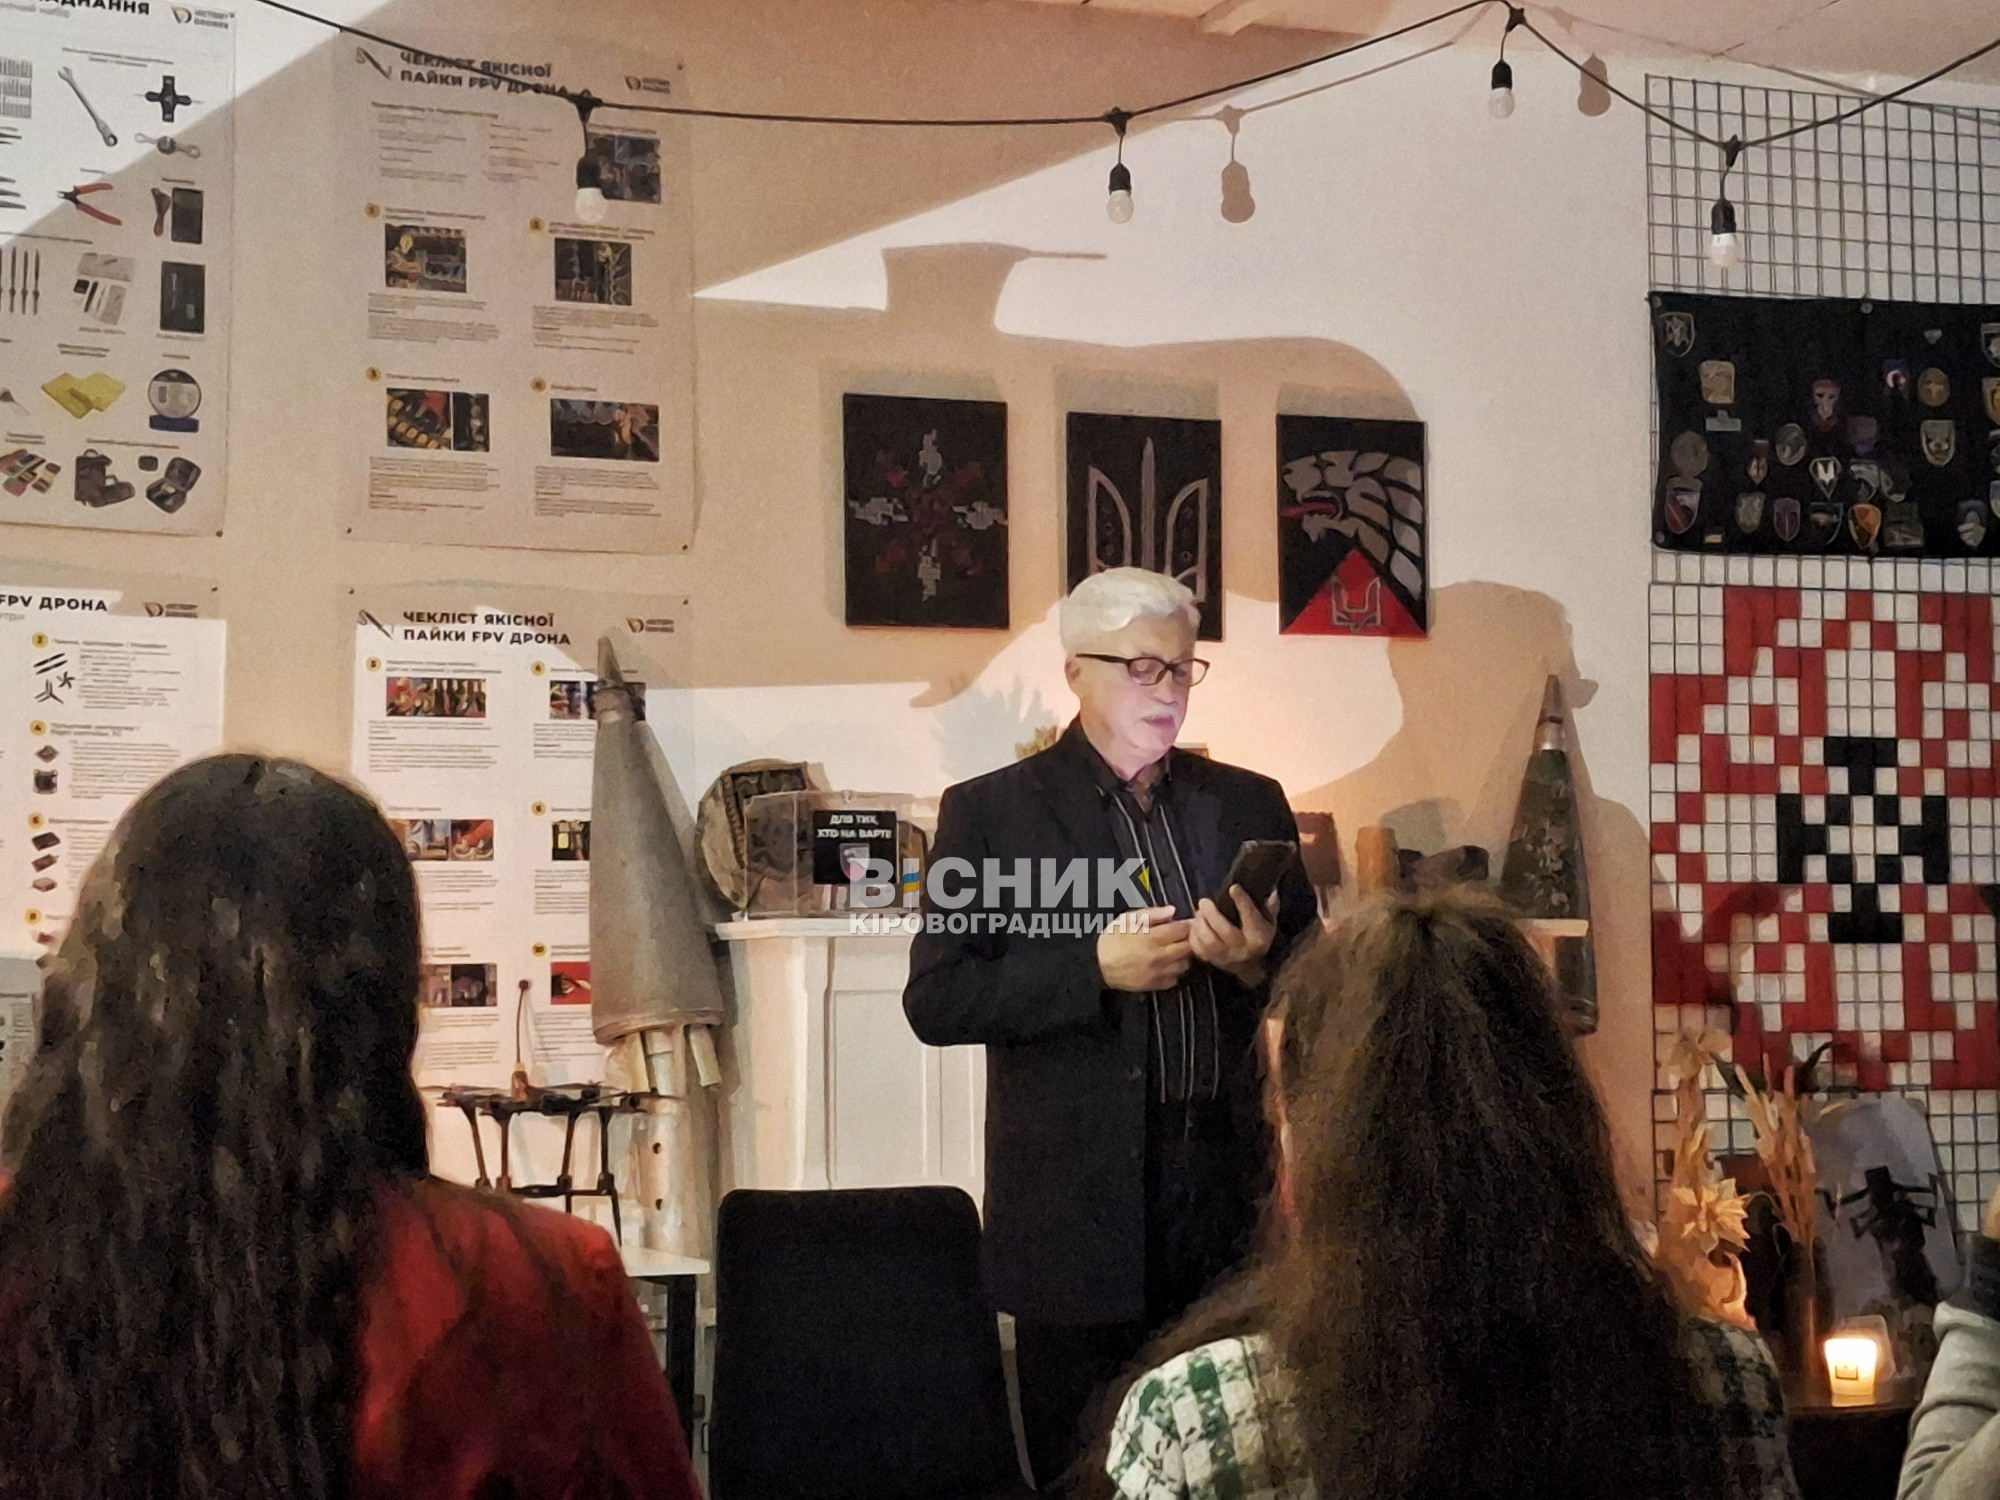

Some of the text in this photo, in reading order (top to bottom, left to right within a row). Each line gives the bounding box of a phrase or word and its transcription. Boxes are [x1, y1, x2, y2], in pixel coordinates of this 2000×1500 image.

[481, 60, 552, 78] ЯКІСНОЇ
[401, 69, 462, 87] ПАЙКИ
[469, 76, 502, 91] FPV
[0, 594, 108, 612] FPV ДРОНА
[403, 611, 555, 628] ЧЕКЛІСТ ЯКІСНОЇ
[403, 628, 572, 646] ПАЙКИ FPV ДРОНА
[840, 829, 858, 839] НА
